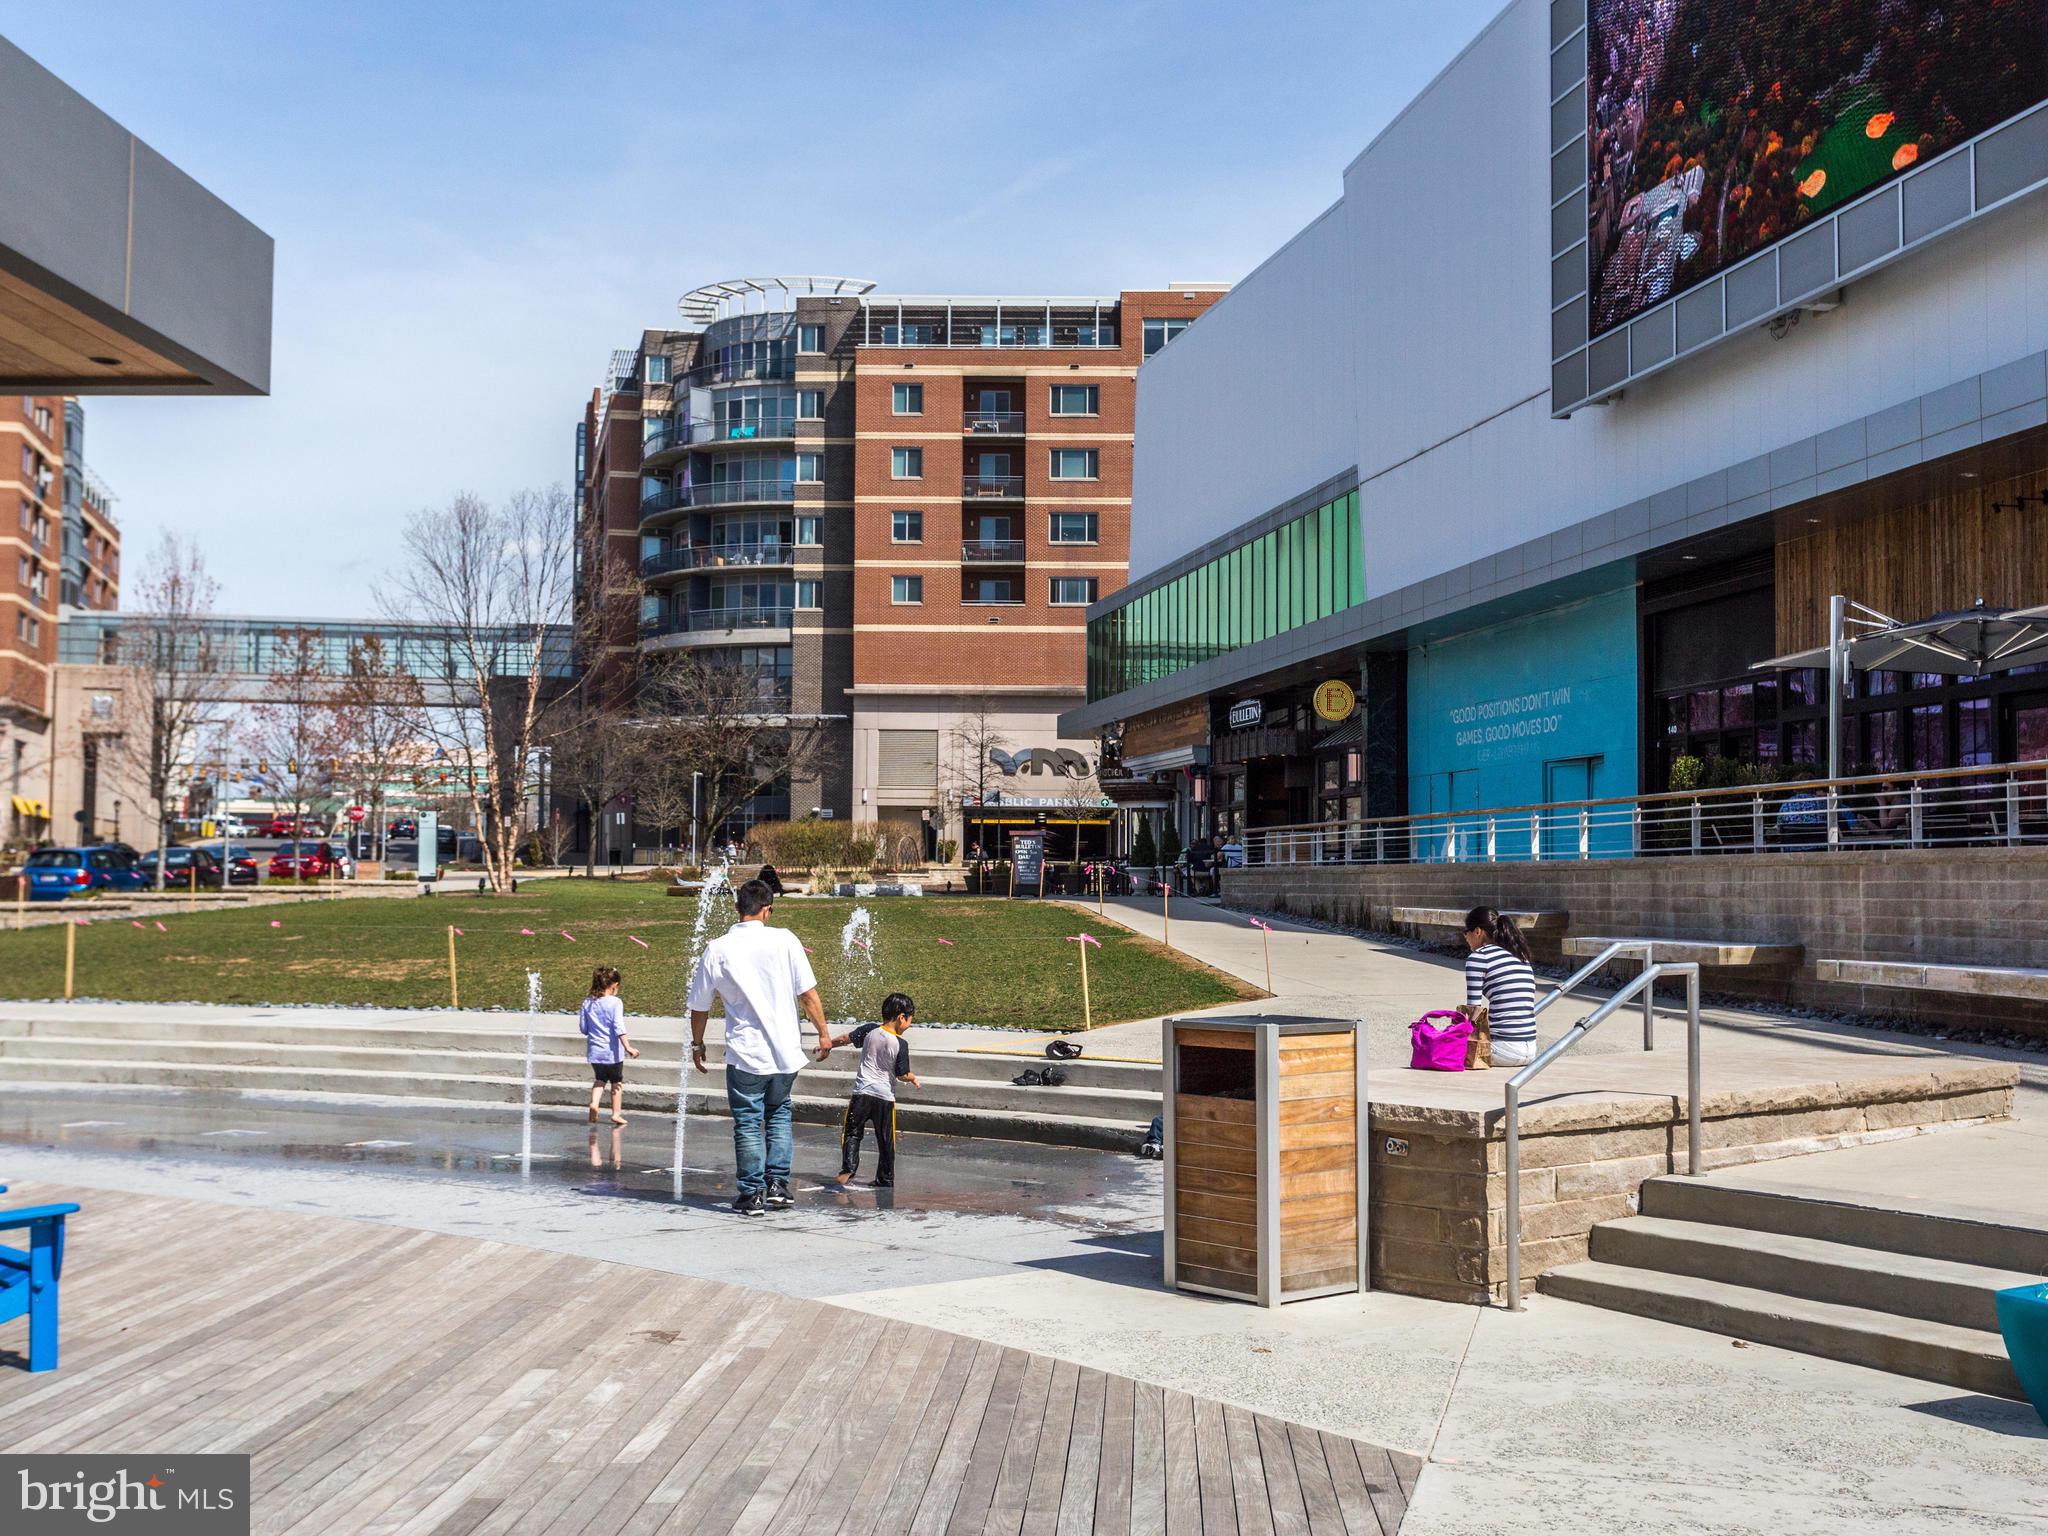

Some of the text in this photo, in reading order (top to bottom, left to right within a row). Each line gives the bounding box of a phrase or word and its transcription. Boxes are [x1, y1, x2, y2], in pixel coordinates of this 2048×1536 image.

[1326, 688, 1348, 712] B
[1478, 697, 1521, 720] POSITIONS
[1551, 687, 1571, 706] WIN
[1232, 706, 1259, 723] BULLETIN
[1485, 724, 1511, 742] GOOD
[1511, 718, 1542, 739] MOVES
